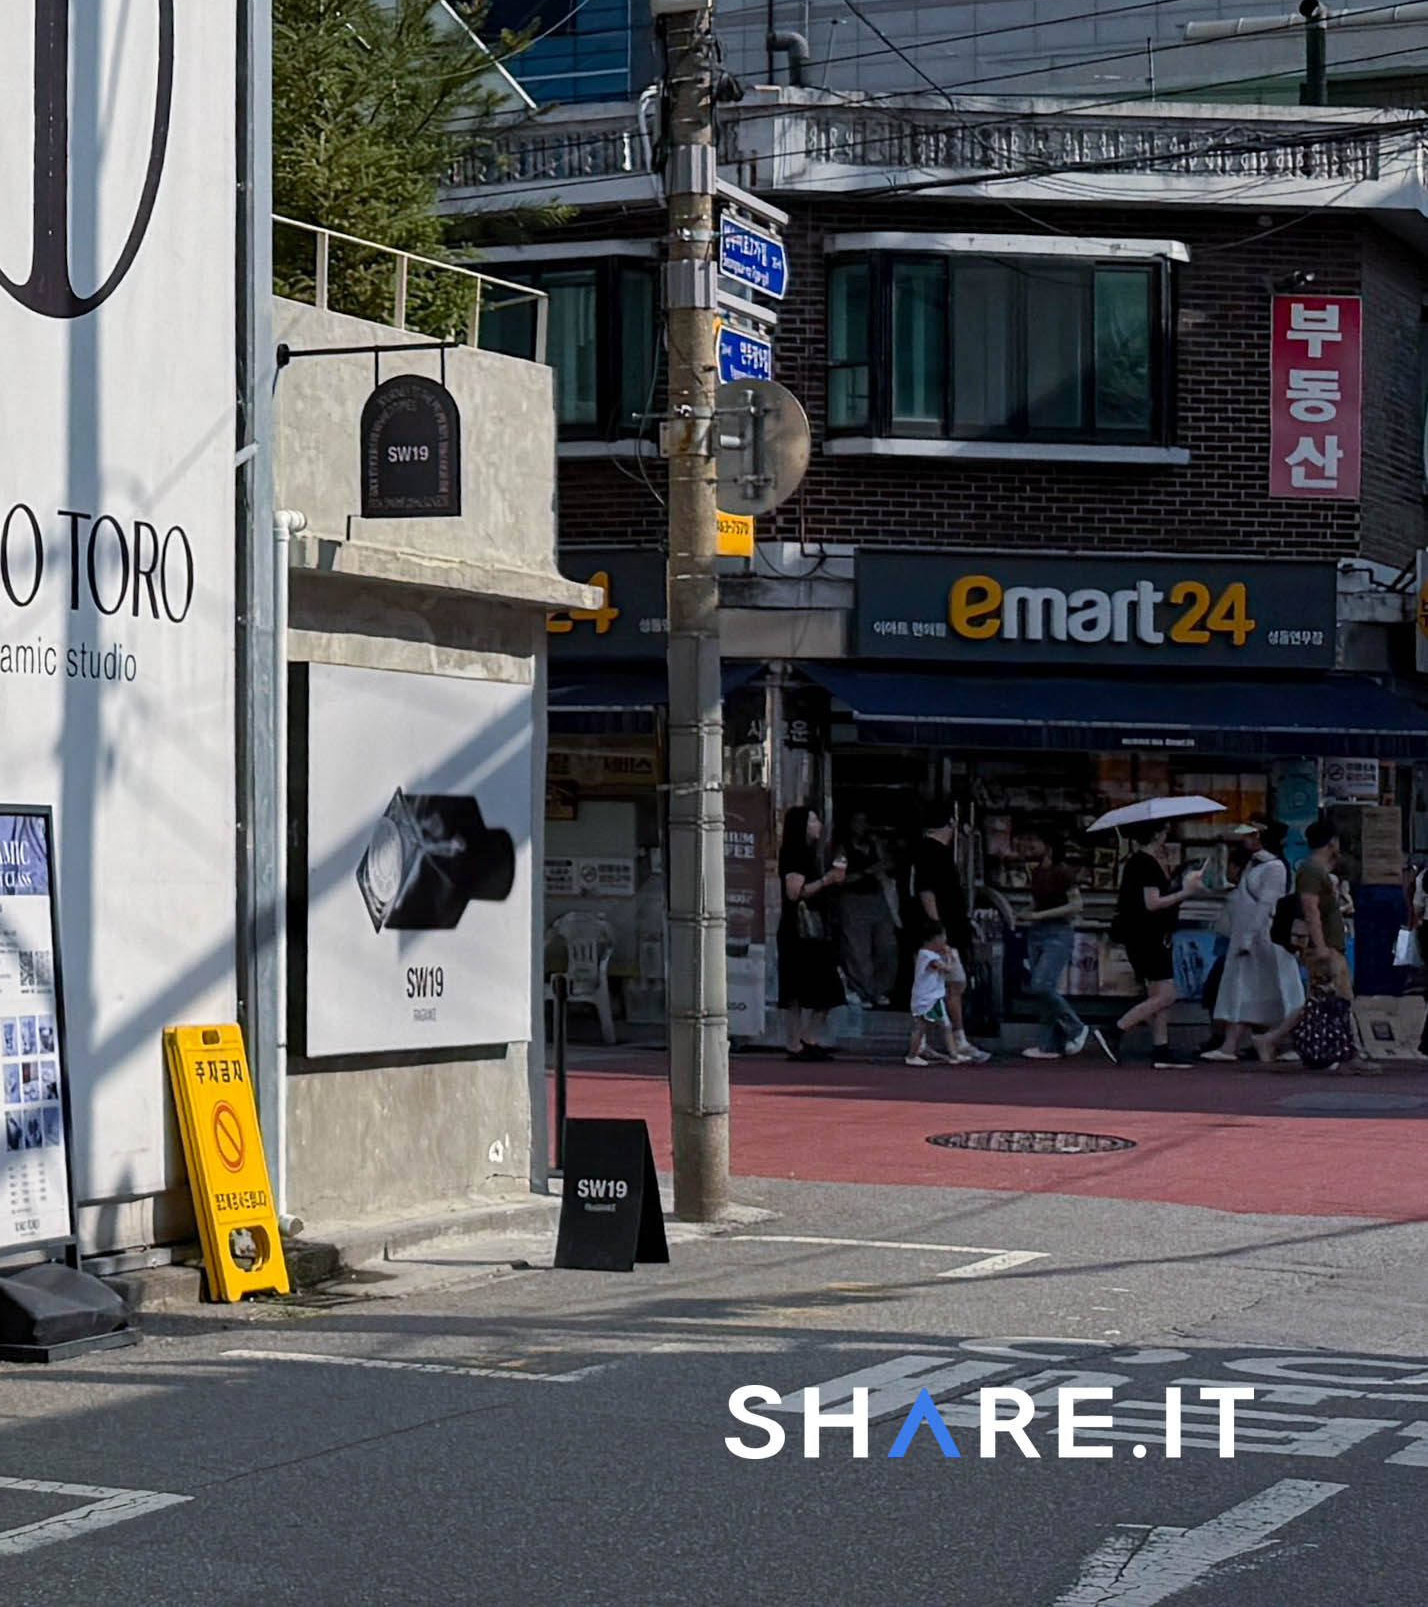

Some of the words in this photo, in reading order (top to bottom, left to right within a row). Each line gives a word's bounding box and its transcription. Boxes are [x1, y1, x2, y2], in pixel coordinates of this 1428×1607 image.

[1285, 303, 1343, 489] 부동산
[388, 446, 429, 462] SW19
[57, 509, 194, 623] TORO
[948, 573, 1256, 646] emart24
[66, 642, 137, 682] studio
[406, 966, 444, 998] SW19
[577, 1179, 628, 1198] SW19
